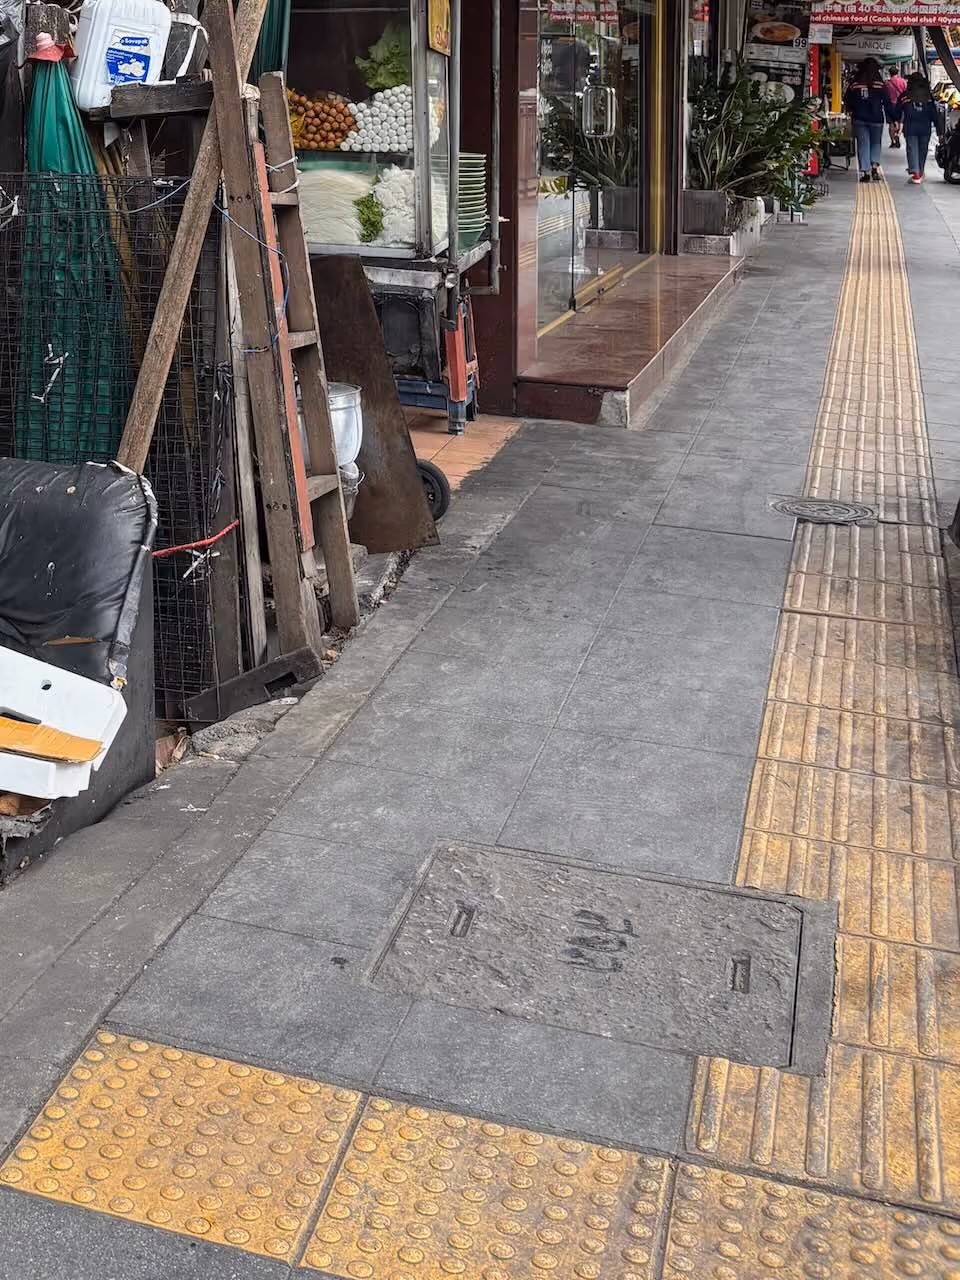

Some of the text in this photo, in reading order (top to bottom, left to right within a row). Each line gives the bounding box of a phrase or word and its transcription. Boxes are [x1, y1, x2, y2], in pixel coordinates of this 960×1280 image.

[822, 13, 849, 22] chinese
[851, 14, 868, 22] food
[892, 16, 901, 25] by
[794, 39, 807, 48] 99
[858, 40, 891, 50] UNIQUE
